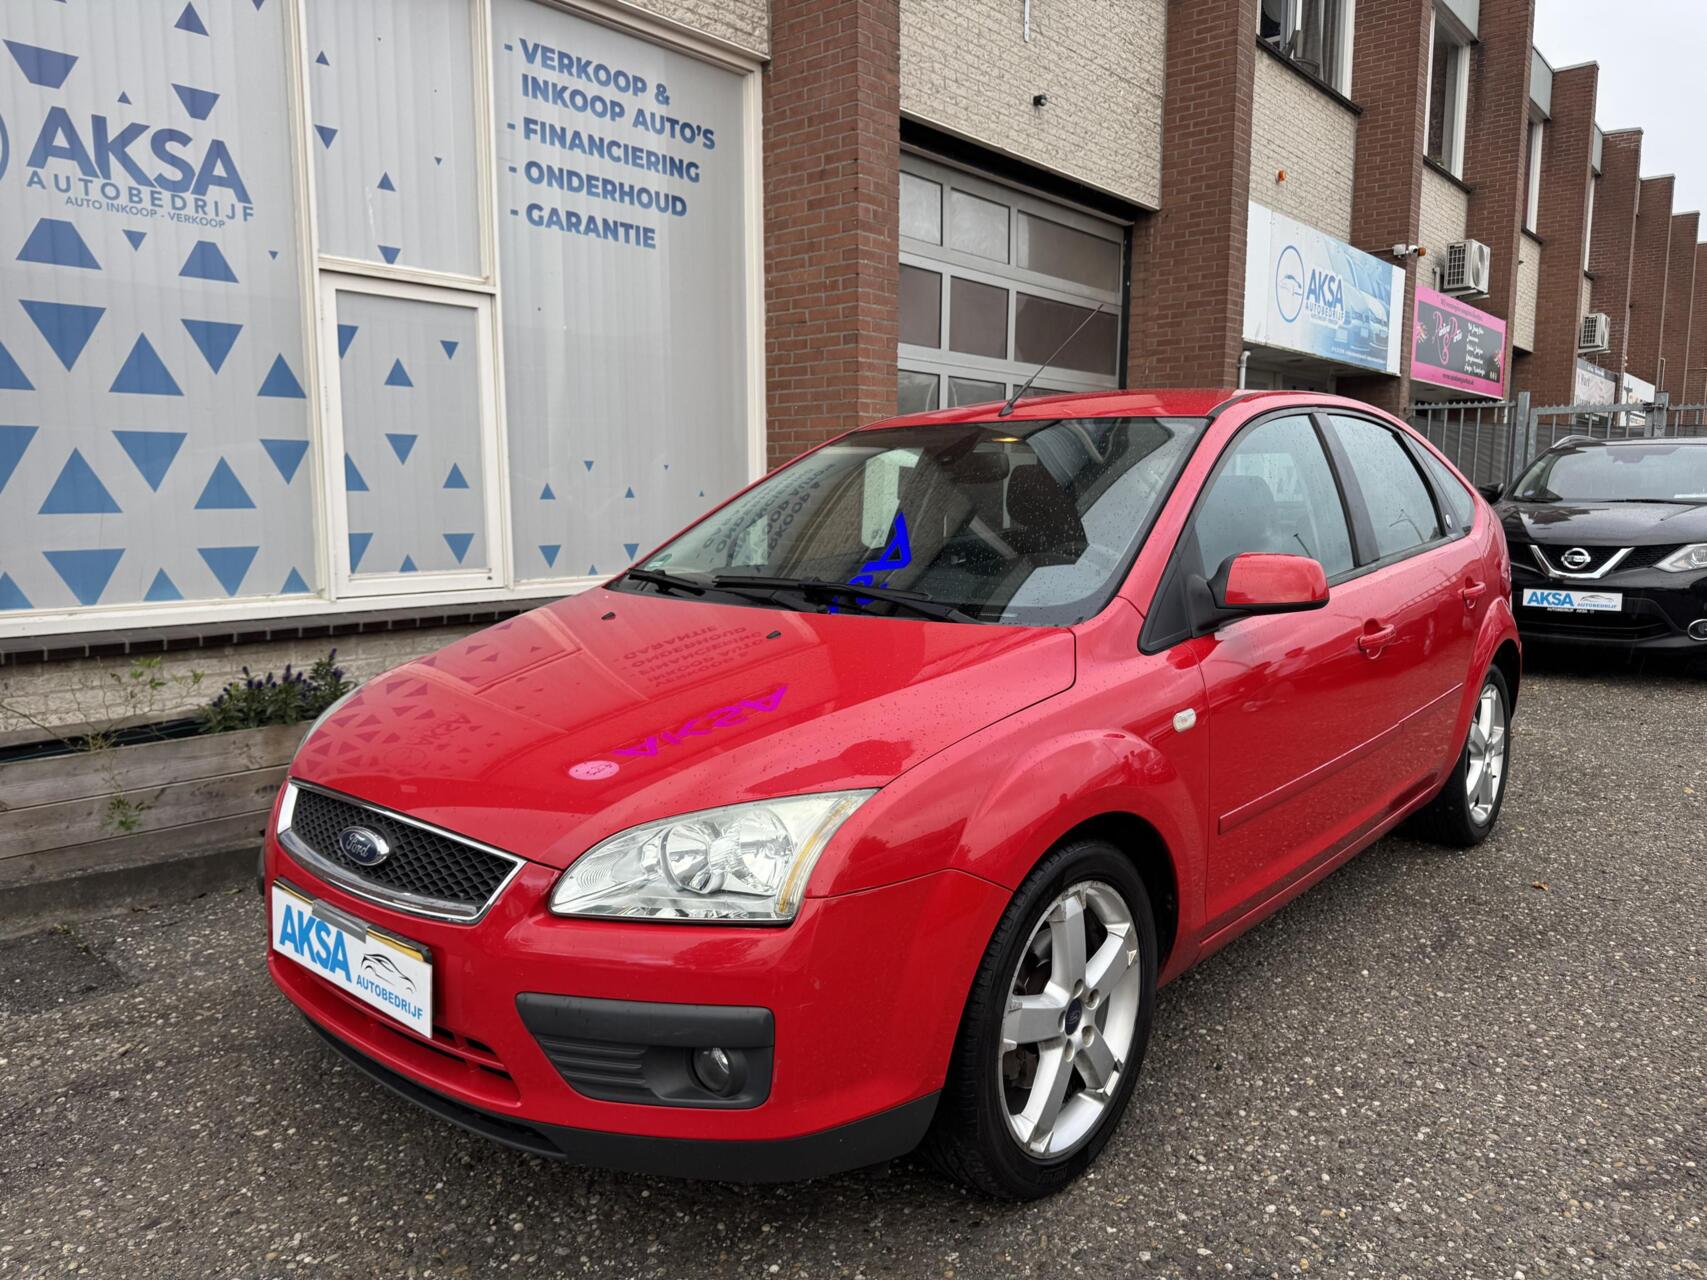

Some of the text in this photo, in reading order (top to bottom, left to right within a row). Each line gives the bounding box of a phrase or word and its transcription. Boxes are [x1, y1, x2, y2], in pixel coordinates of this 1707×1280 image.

[519, 38, 647, 97] VERKOOP
[655, 83, 670, 106] &
[522, 73, 716, 150] INKOOP AUTO'S
[26, 105, 253, 205] AKSA
[523, 116, 700, 183] FINANCIERING
[26, 170, 254, 222] AUTOBEDRIJF
[65, 195, 103, 210] AUTO
[106, 201, 157, 218] INKOOP
[167, 212, 226, 229] VERKOOP
[524, 160, 687, 217] ONDERHOUD
[526, 203, 656, 249] GARANTIE
[1305, 301, 1344, 320] AUTOBEDRIJF
[1306, 268, 1344, 311] AKSA
[1527, 591, 1574, 607] AKSA
[345, 832, 371, 857] Ford
[279, 904, 352, 983] AKSA
[356, 974, 423, 1020] AUTOBEDRIJF
